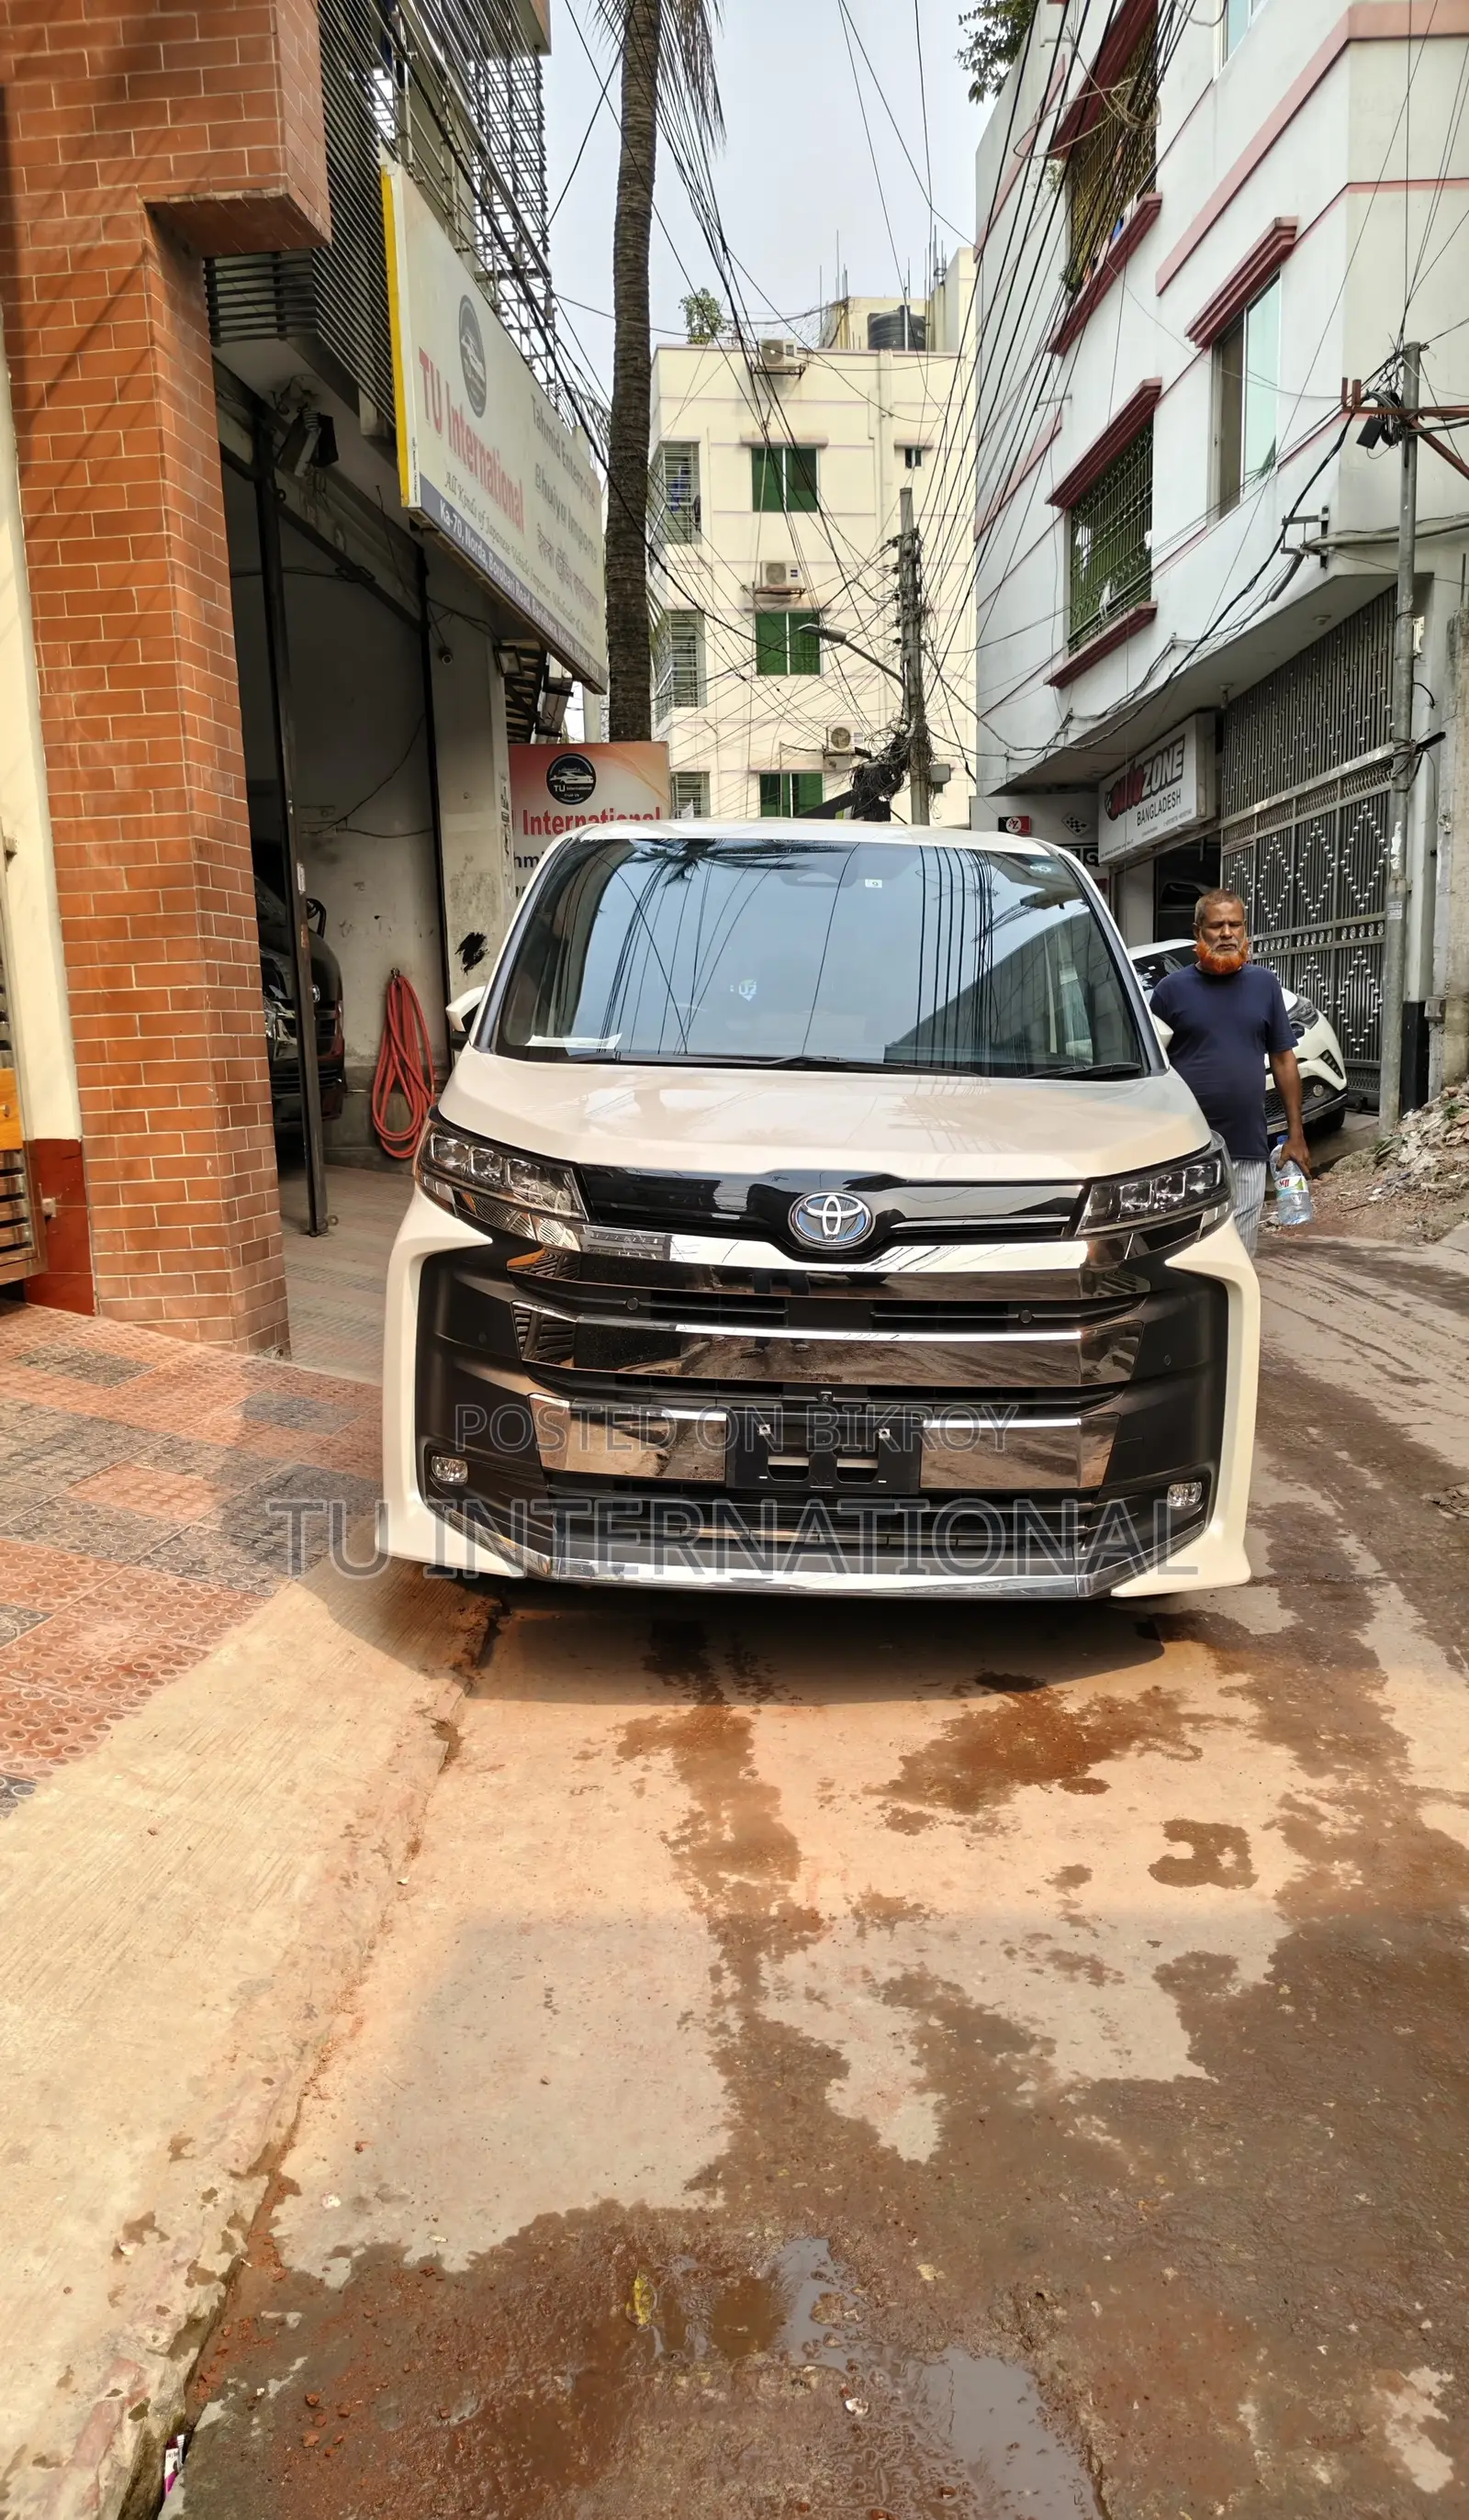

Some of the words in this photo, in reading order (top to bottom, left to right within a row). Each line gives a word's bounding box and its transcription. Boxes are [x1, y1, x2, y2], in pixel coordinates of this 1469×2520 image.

[420, 345, 442, 435] TU
[446, 380, 524, 534] International
[532, 394, 560, 460] Tahmid
[561, 439, 595, 511] Enterprise
[440, 498, 464, 543] Ka-70,
[465, 525, 488, 569] Norda,
[488, 551, 515, 597] Borobari
[515, 580, 532, 613] Road,
[445, 471, 457, 496] All
[458, 483, 477, 519] Kinds
[478, 510, 486, 531] of
[487, 516, 510, 555] Japanese
[535, 462, 566, 526] Bhuiya
[567, 508, 597, 566] Imports
[1137, 788, 1182, 826] BANGLADESH
